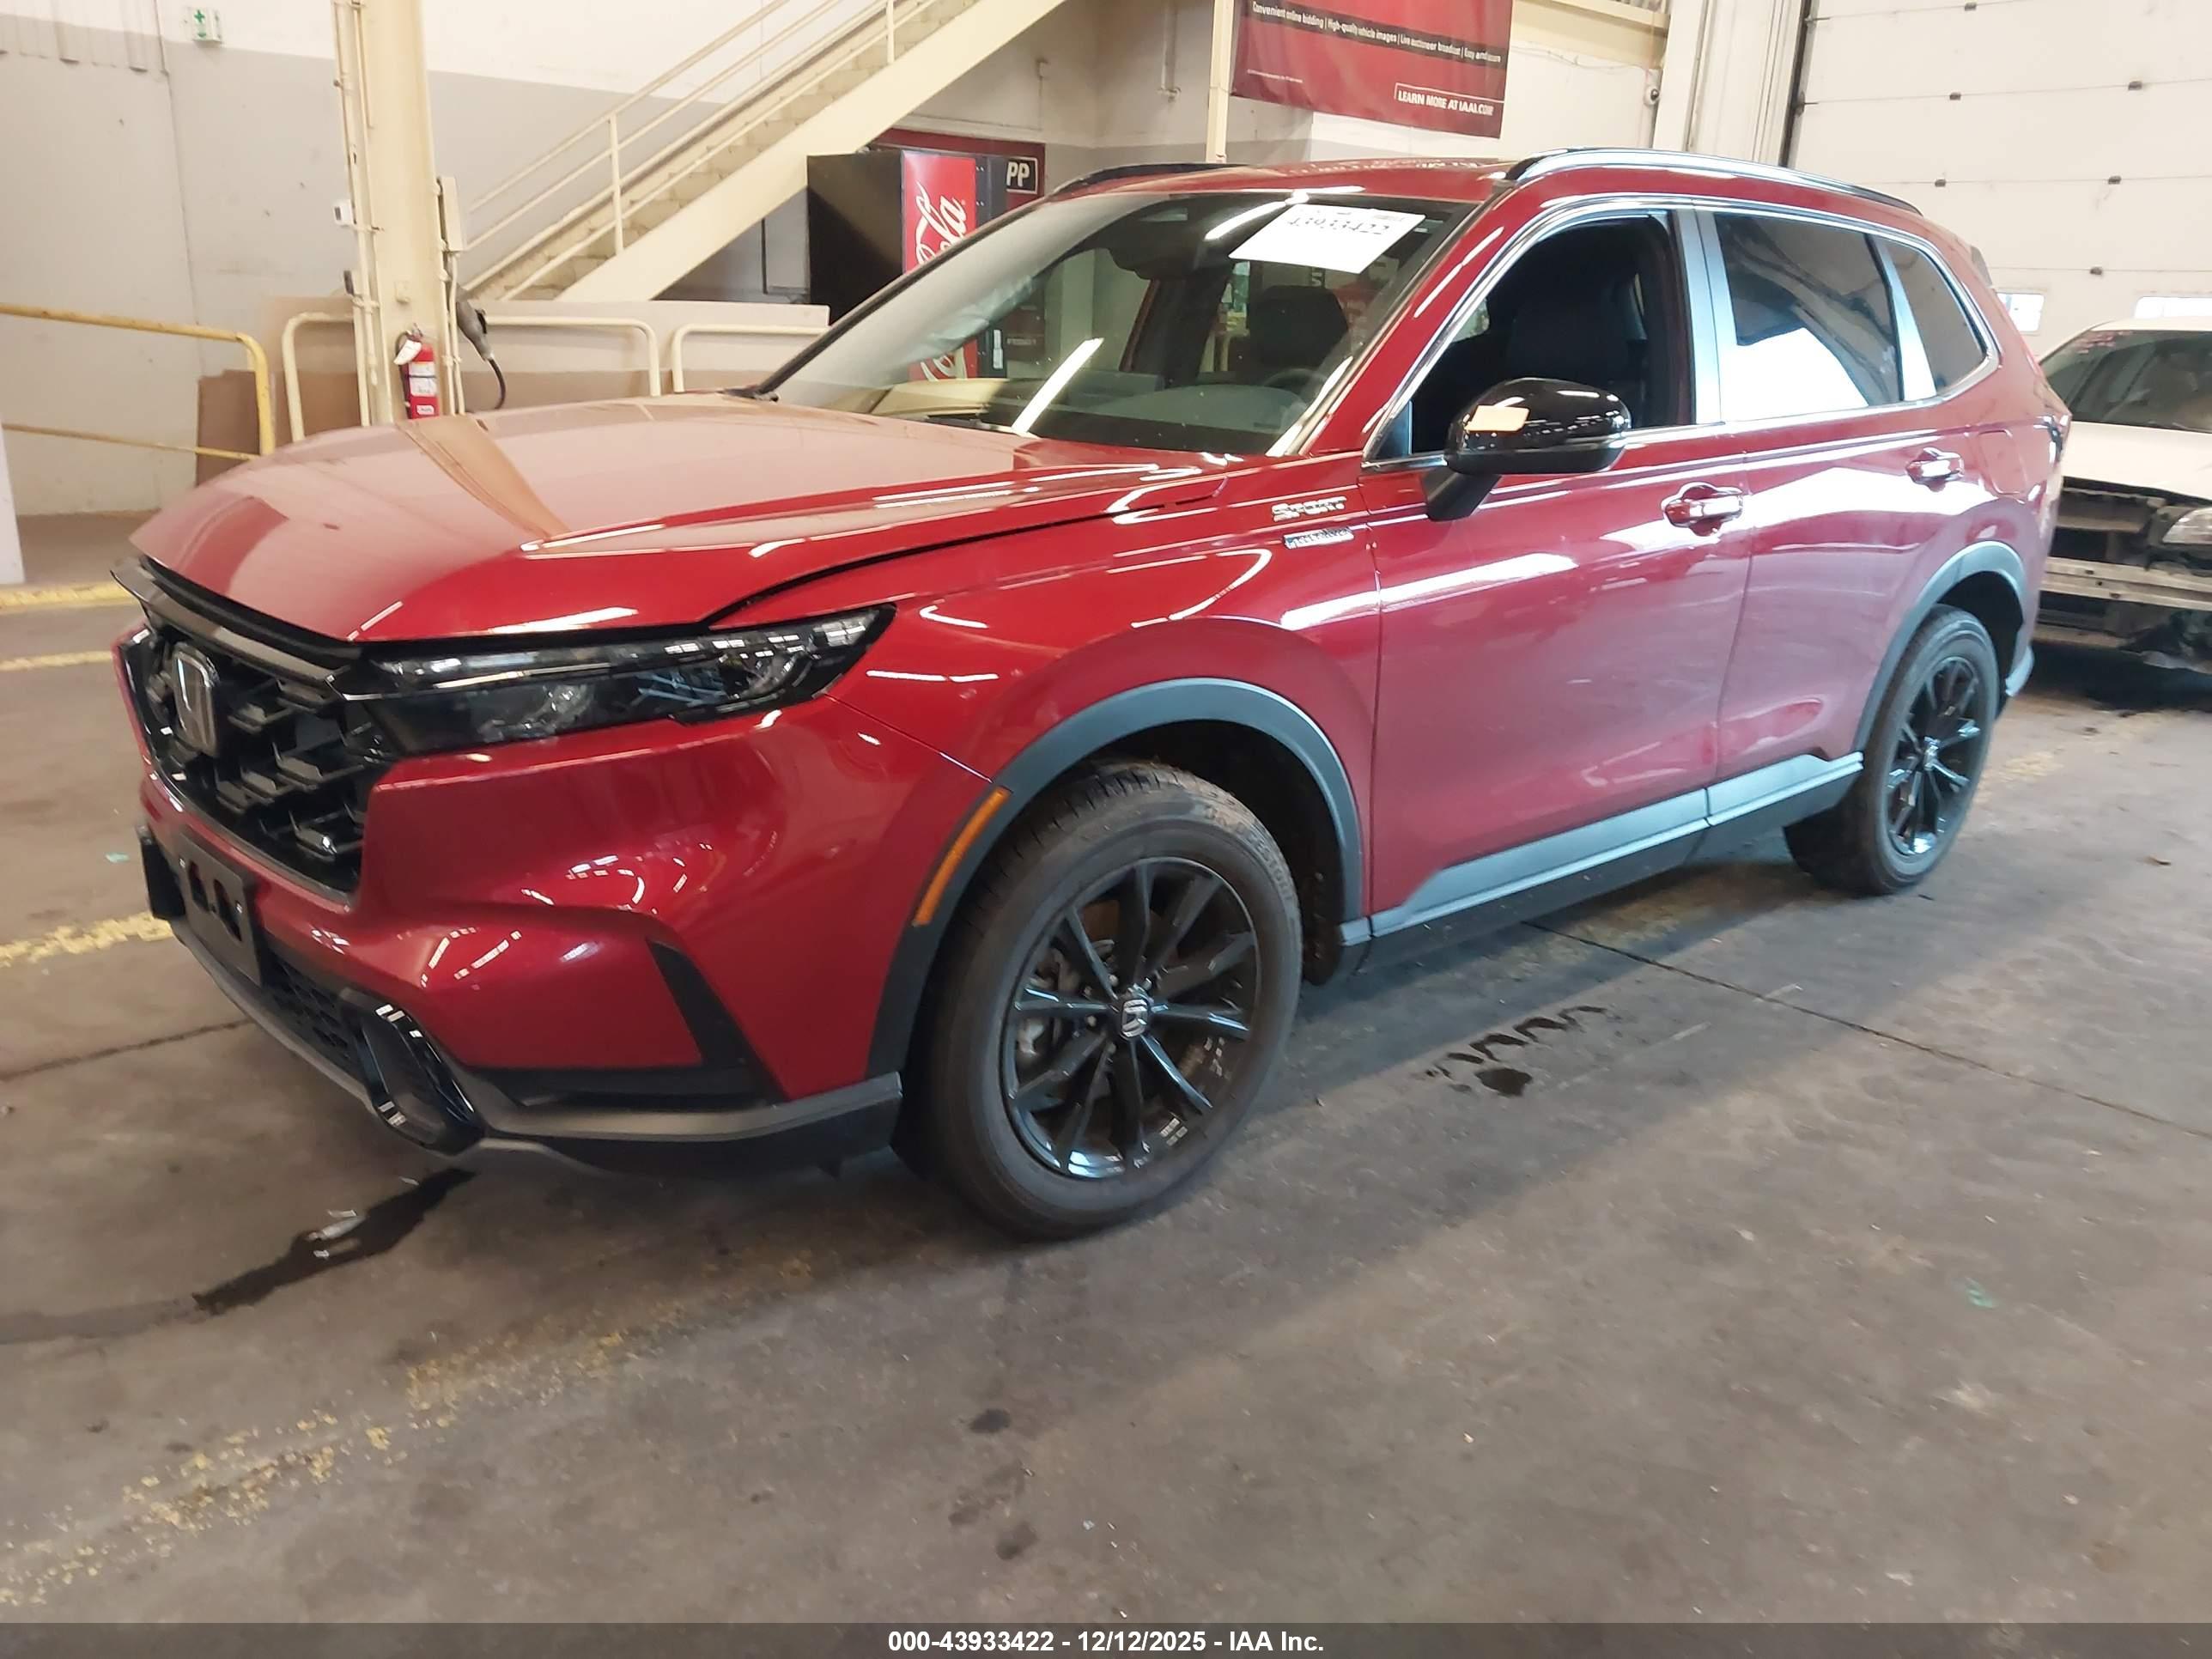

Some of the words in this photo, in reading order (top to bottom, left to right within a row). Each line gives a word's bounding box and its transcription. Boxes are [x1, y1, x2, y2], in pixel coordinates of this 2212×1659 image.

[1398, 90, 1425, 106] LEARN
[1425, 94, 1447, 109] MORE
[1448, 99, 1458, 111] AT
[1006, 161, 1030, 187] PP
